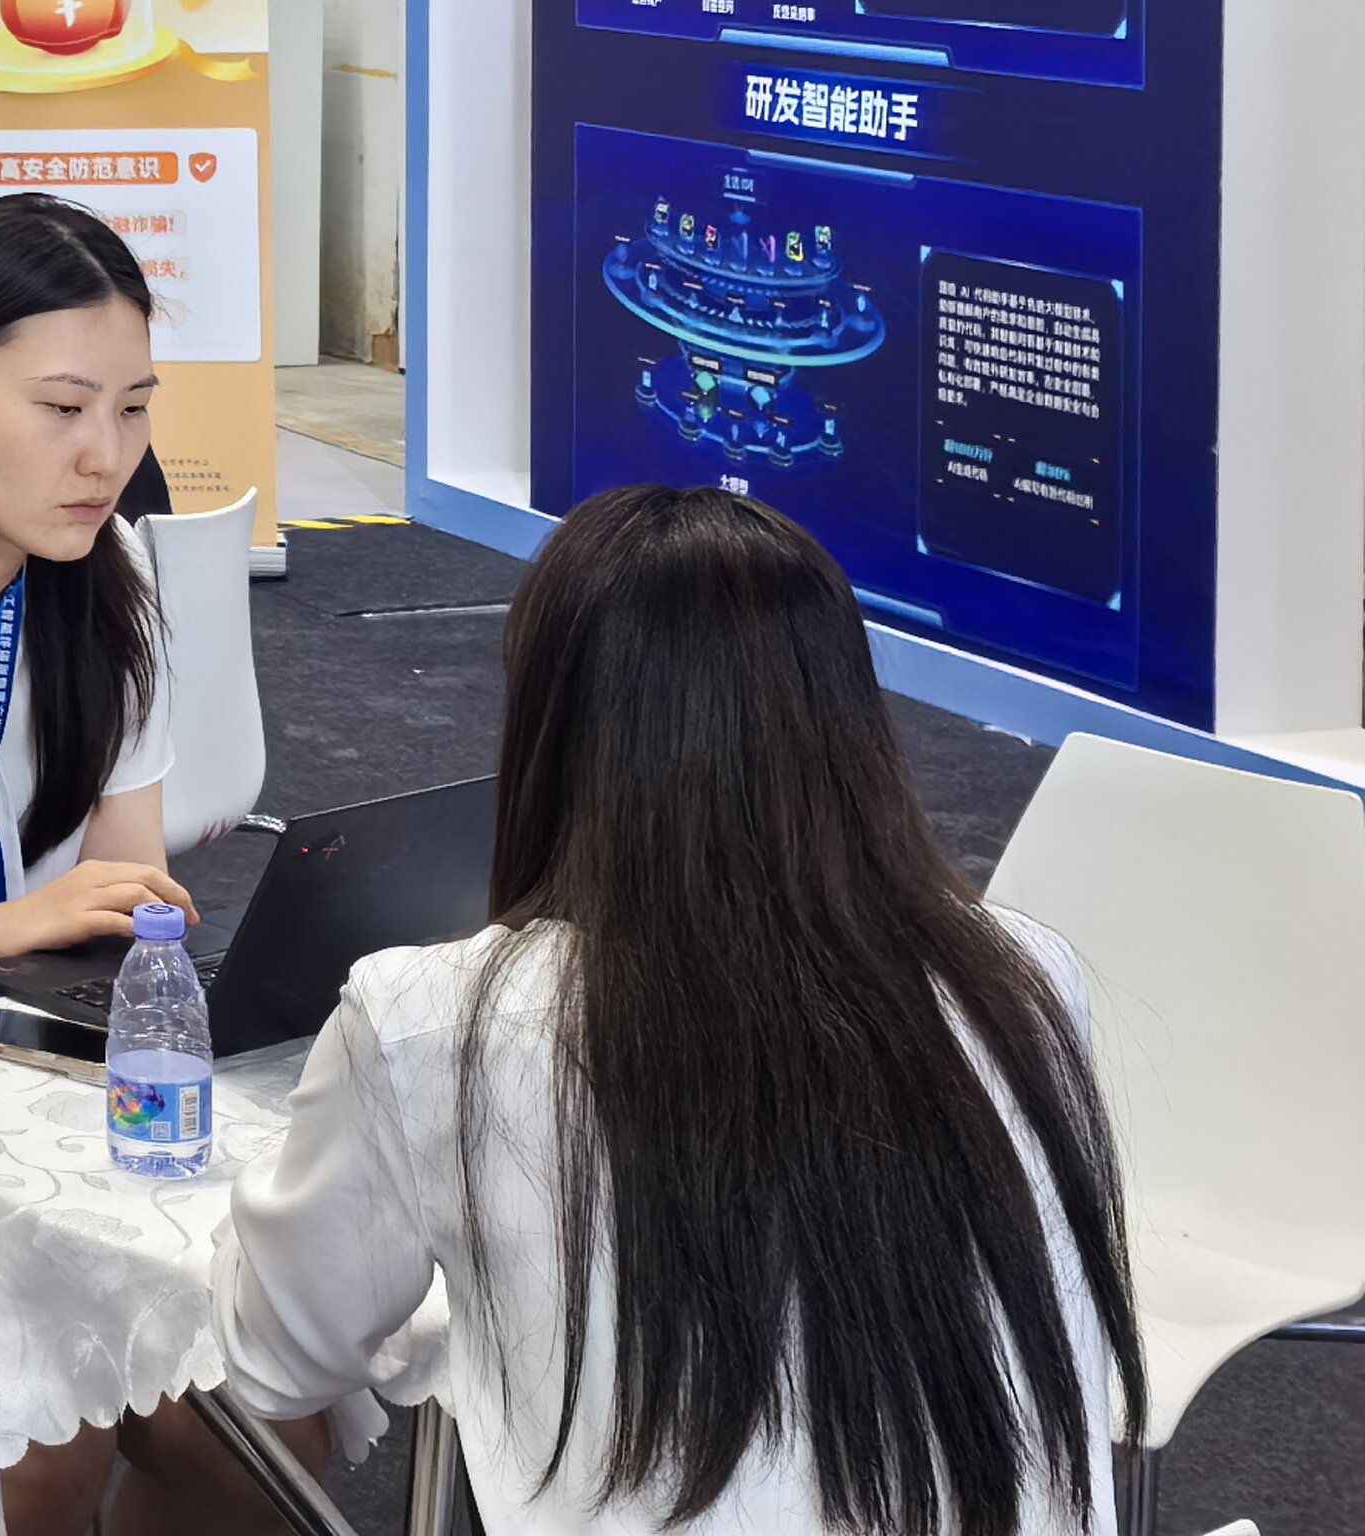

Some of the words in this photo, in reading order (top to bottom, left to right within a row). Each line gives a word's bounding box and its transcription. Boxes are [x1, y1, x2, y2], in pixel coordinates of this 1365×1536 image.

[746, 74, 919, 142] 研发智能助手
